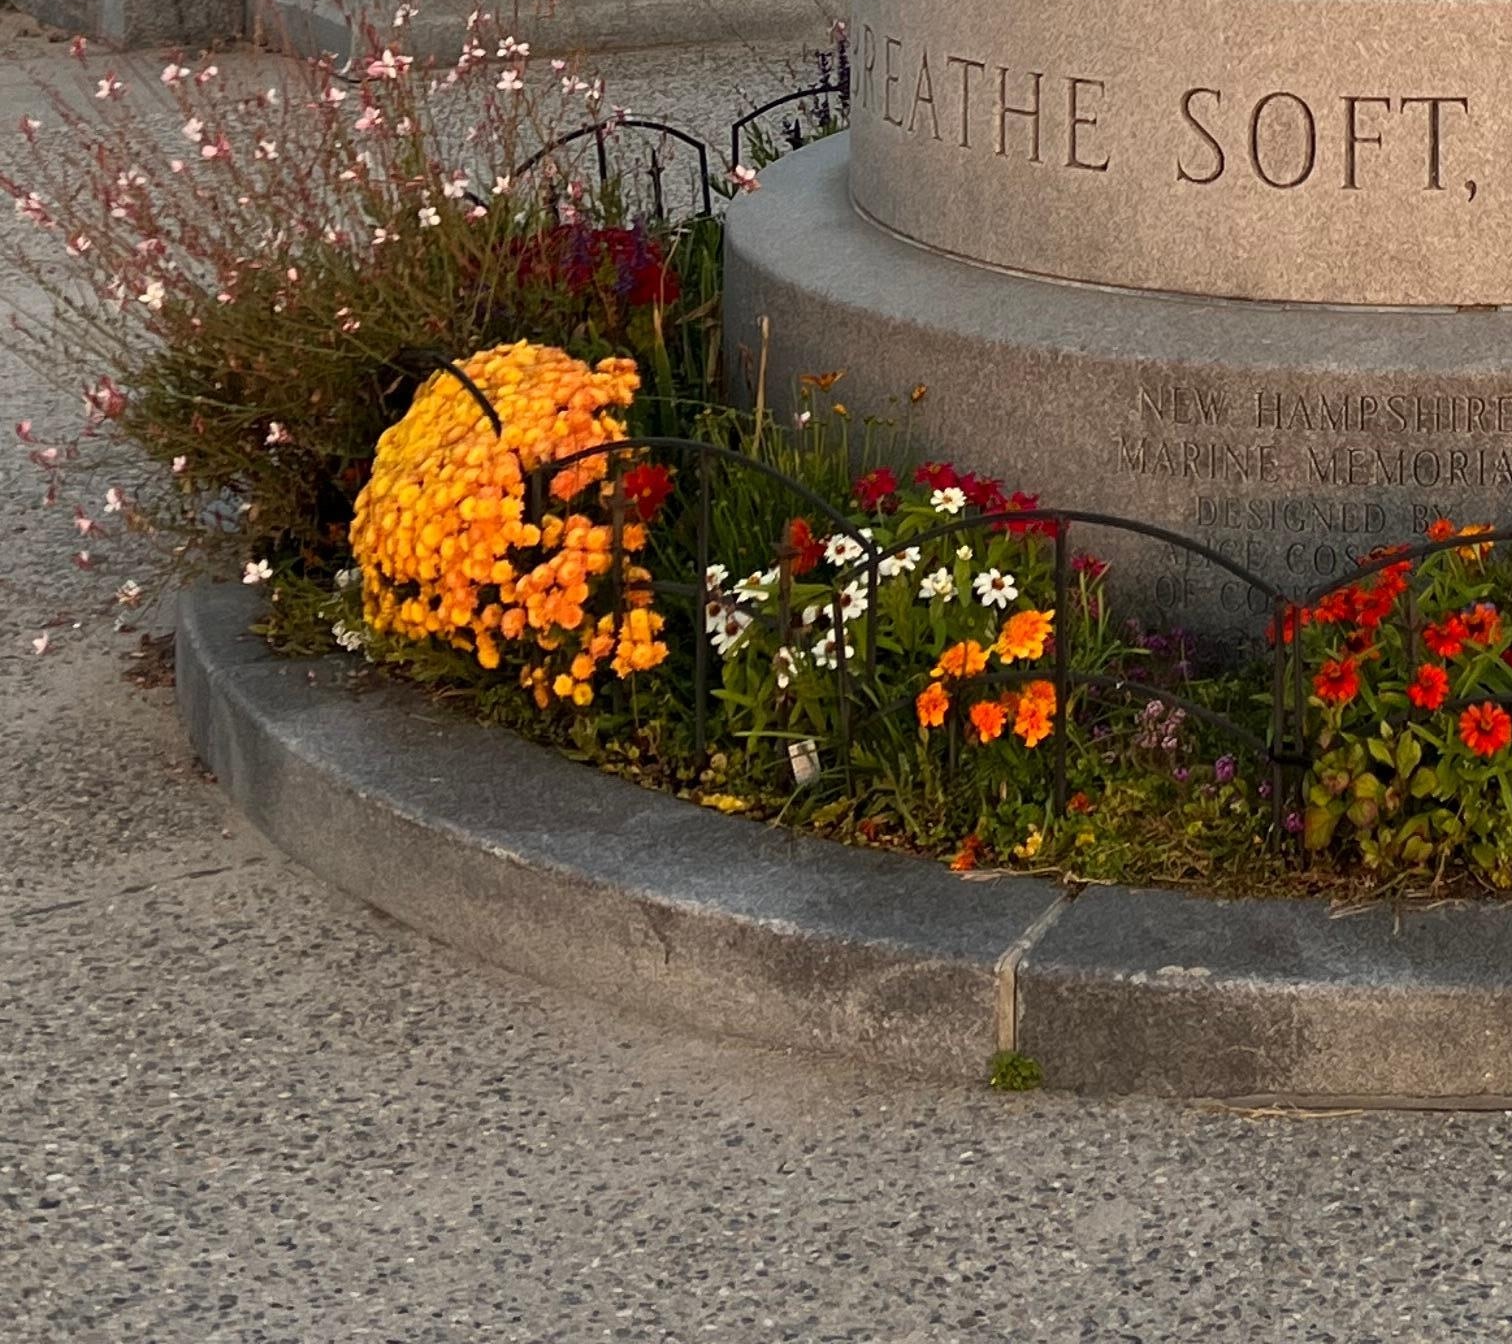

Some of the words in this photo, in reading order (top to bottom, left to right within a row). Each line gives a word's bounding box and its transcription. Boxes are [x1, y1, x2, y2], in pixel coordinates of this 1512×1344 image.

[1176, 86, 1478, 202] SOFT,
[1139, 385, 1228, 428] NEW
[1112, 434, 1281, 484] MARINE
[1196, 495, 1387, 535] DESIGNED
